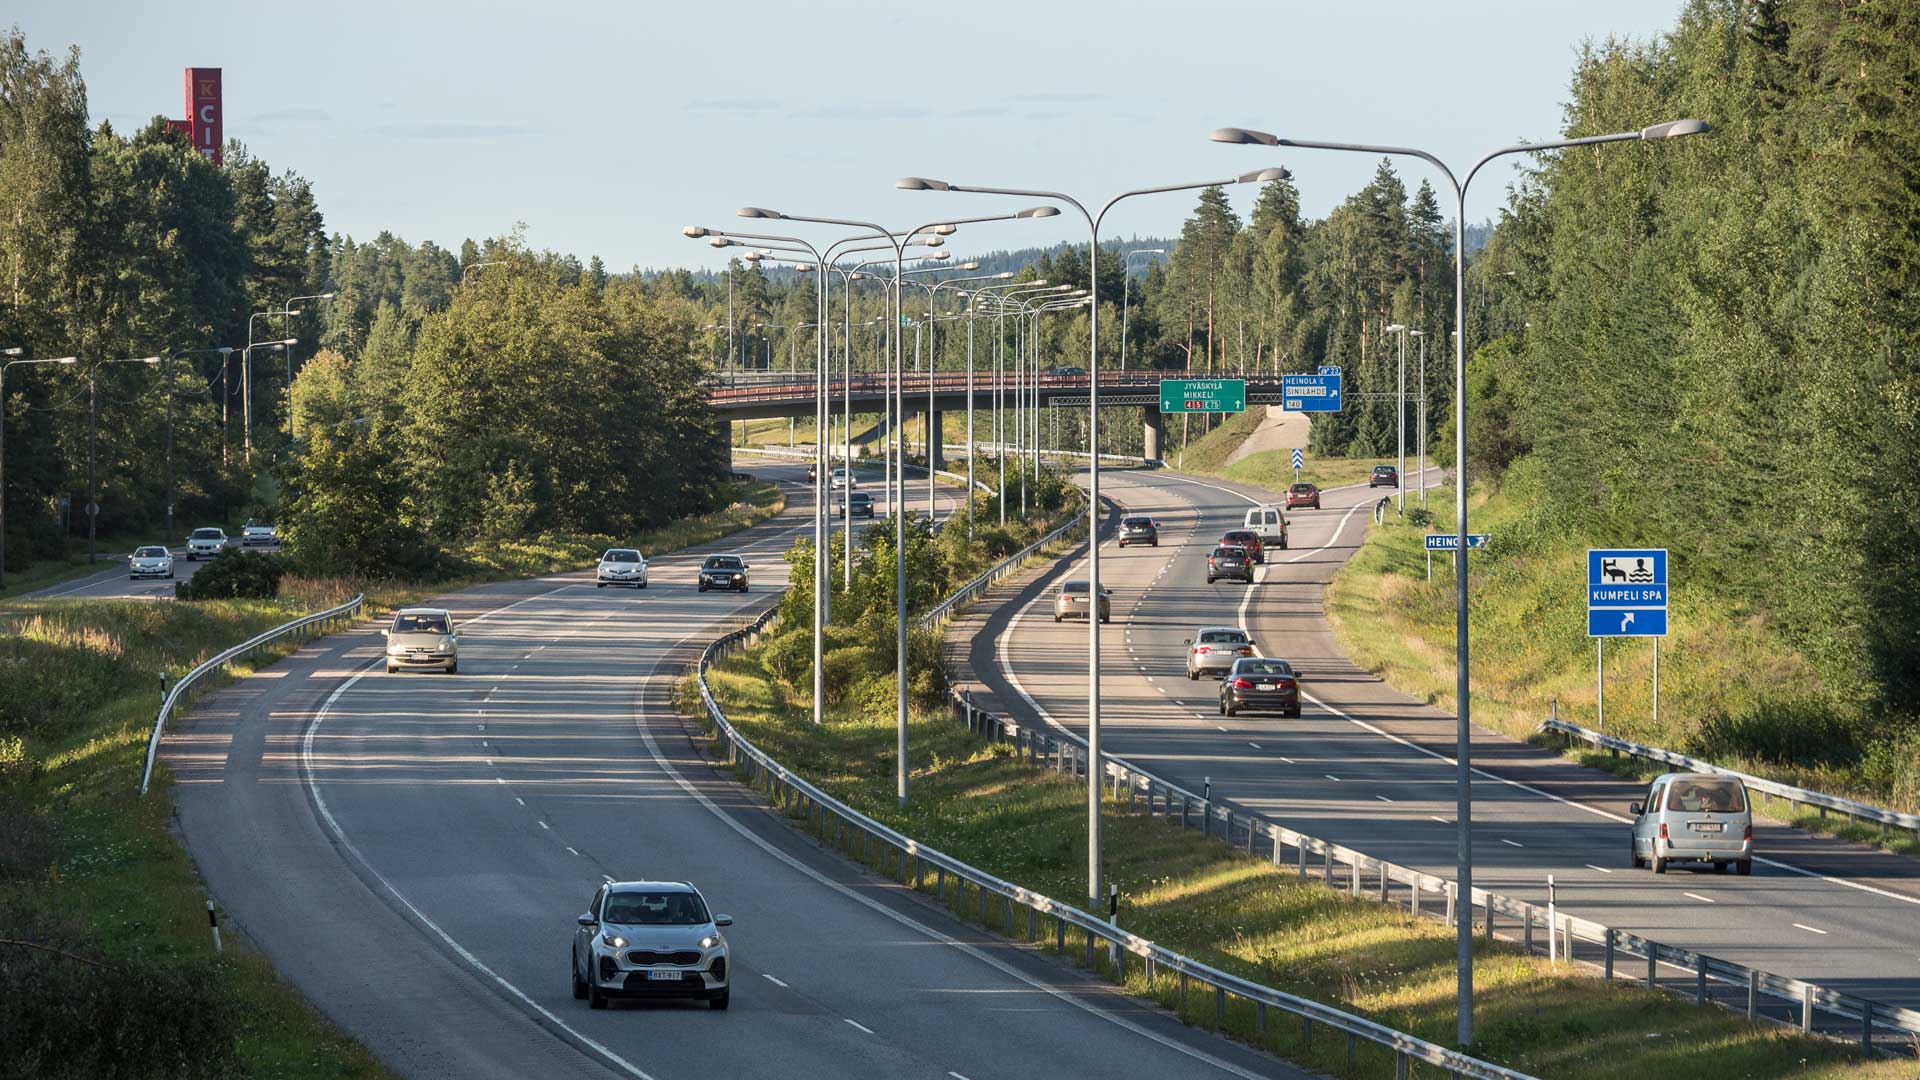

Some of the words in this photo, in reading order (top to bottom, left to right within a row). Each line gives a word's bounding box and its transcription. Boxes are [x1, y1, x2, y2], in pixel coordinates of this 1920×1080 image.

[1285, 377, 1317, 385] HEINOLA
[1320, 377, 1325, 385] E
[1183, 382, 1223, 390] JYVÄSKYLÄ
[1183, 391, 1214, 399] MIKKELI
[1286, 387, 1326, 395] SINILÄHDE
[1593, 590, 1639, 600] KUMPELI
[1642, 590, 1662, 600] SPA
